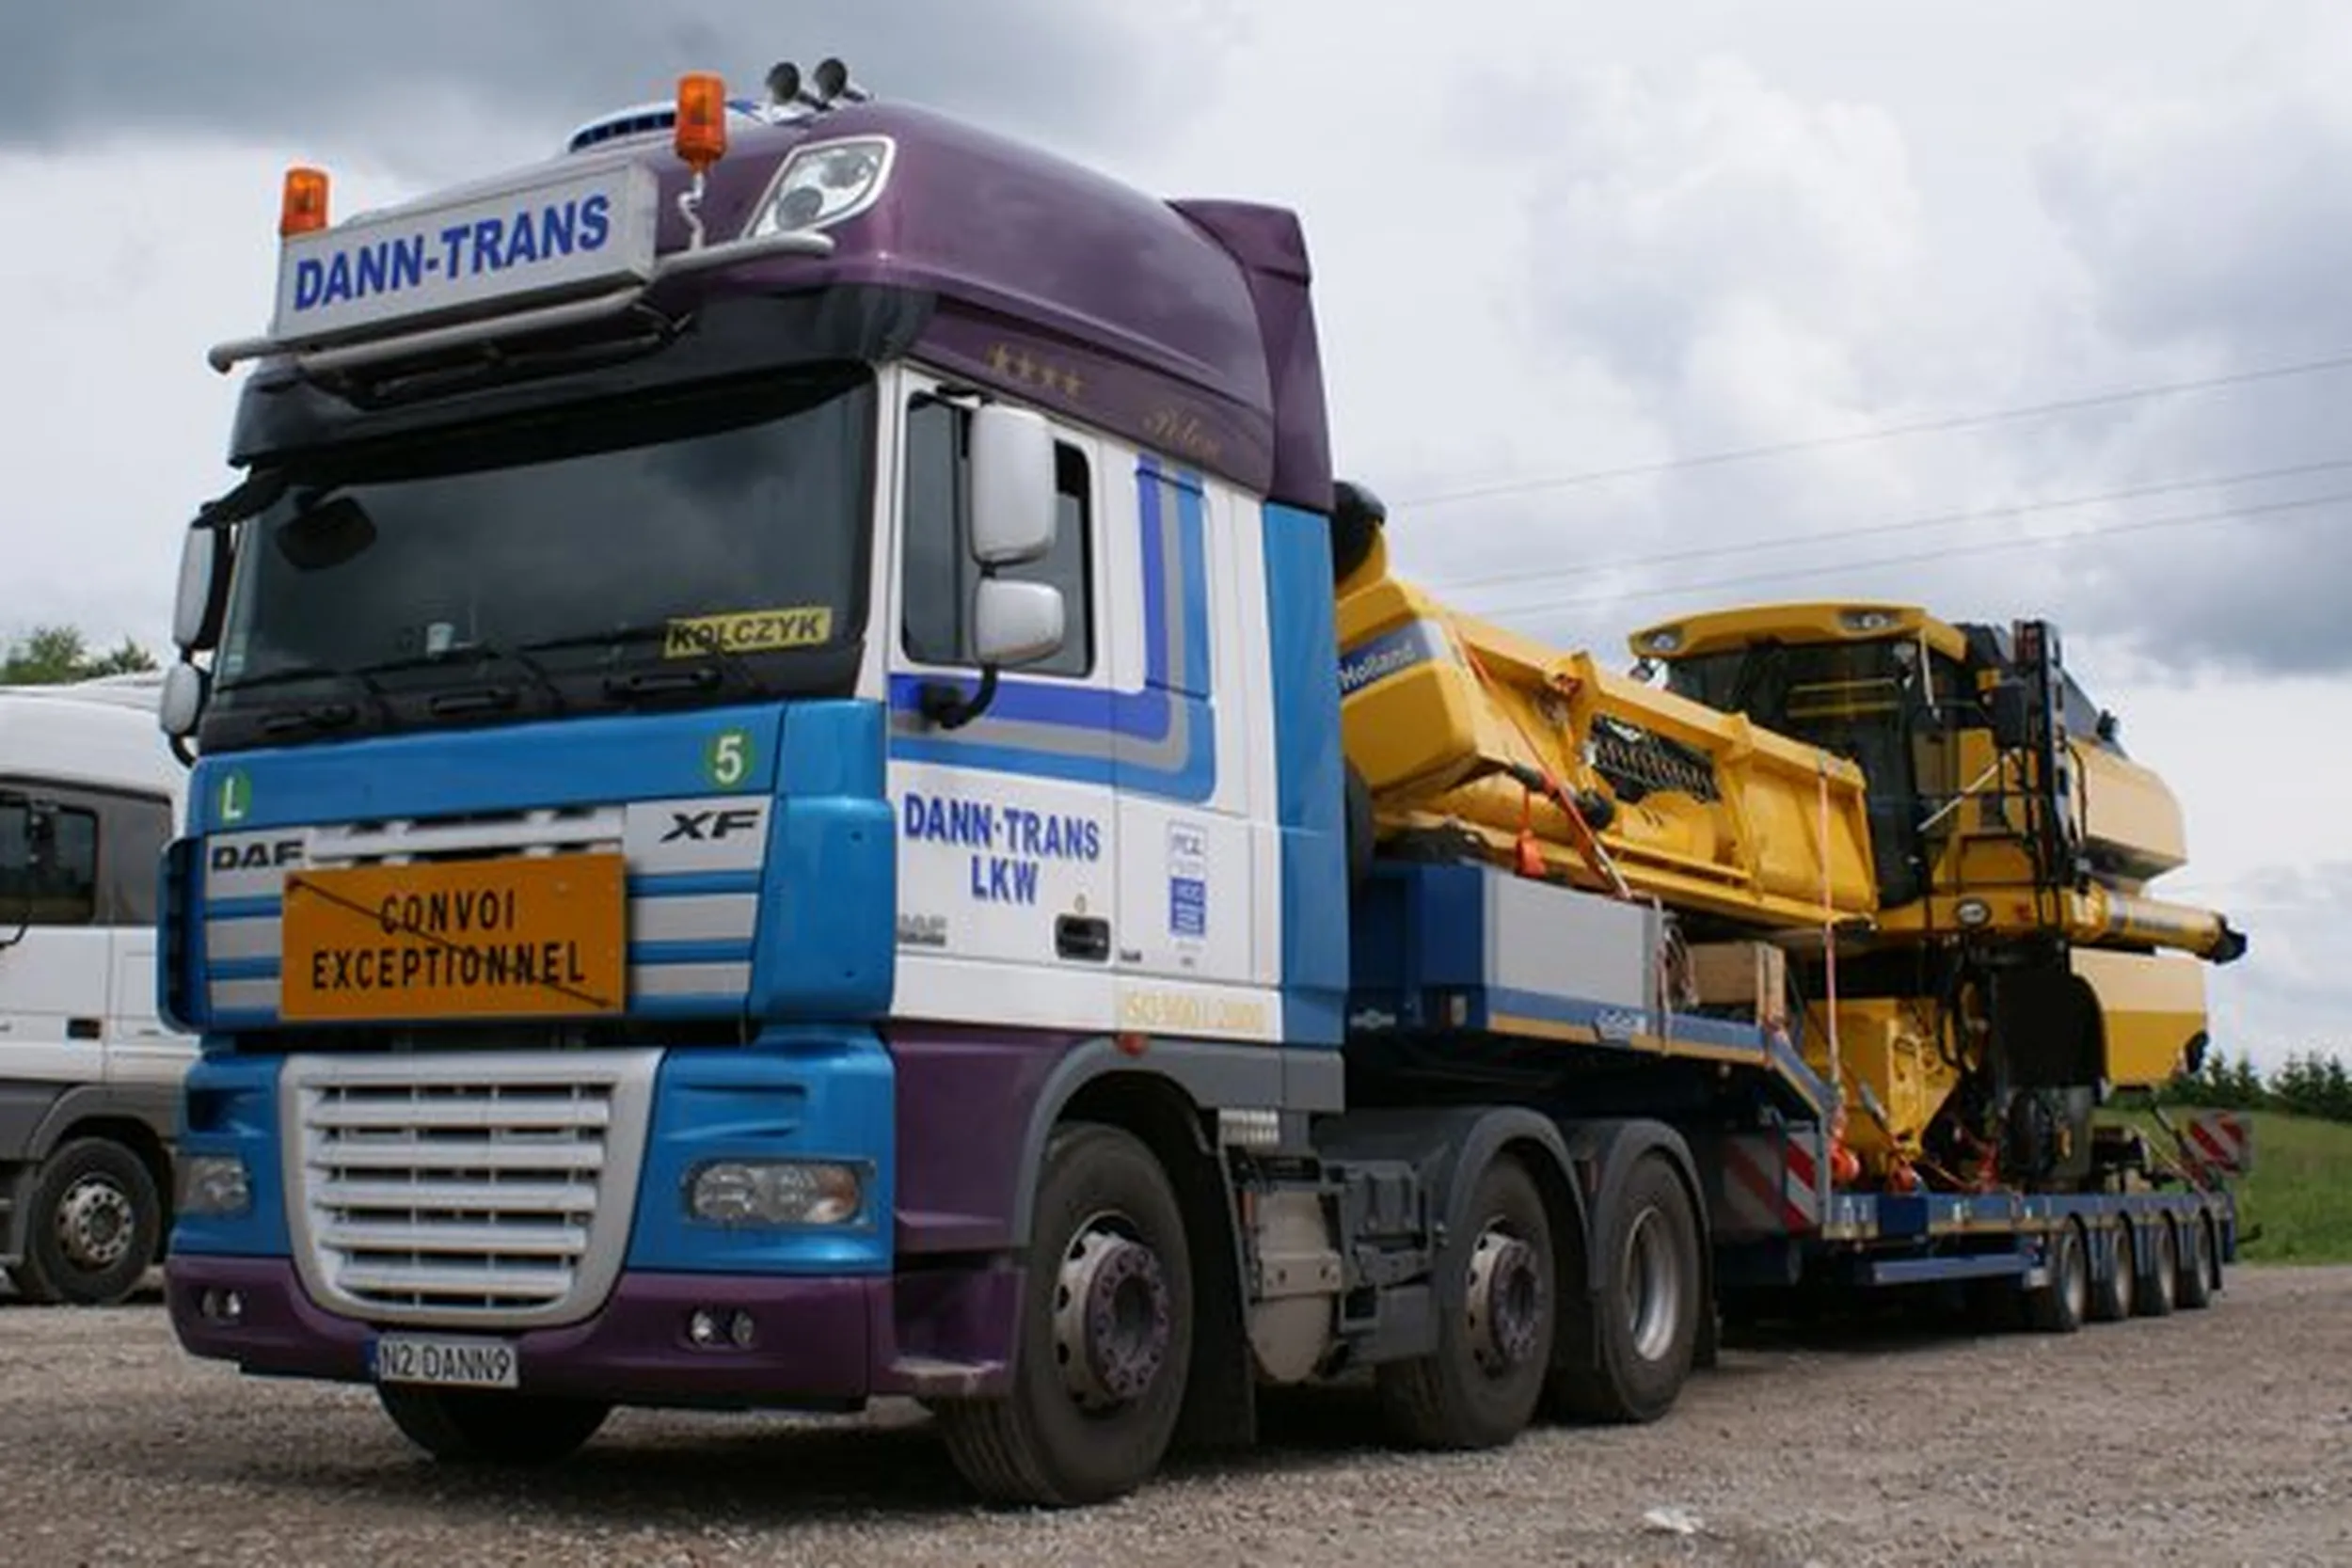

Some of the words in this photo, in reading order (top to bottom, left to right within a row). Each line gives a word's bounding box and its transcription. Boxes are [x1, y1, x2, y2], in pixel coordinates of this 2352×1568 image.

[293, 194, 611, 311] DANN-TRANS
[671, 613, 821, 650] KOLCZYK
[714, 734, 744, 784] 5
[221, 777, 243, 820] L
[659, 808, 762, 843] XF
[210, 838, 305, 872] DAF
[970, 854, 1040, 905] LKW
[379, 889, 516, 935] CONVOI
[311, 942, 585, 991] EXCEPTIONNEL
